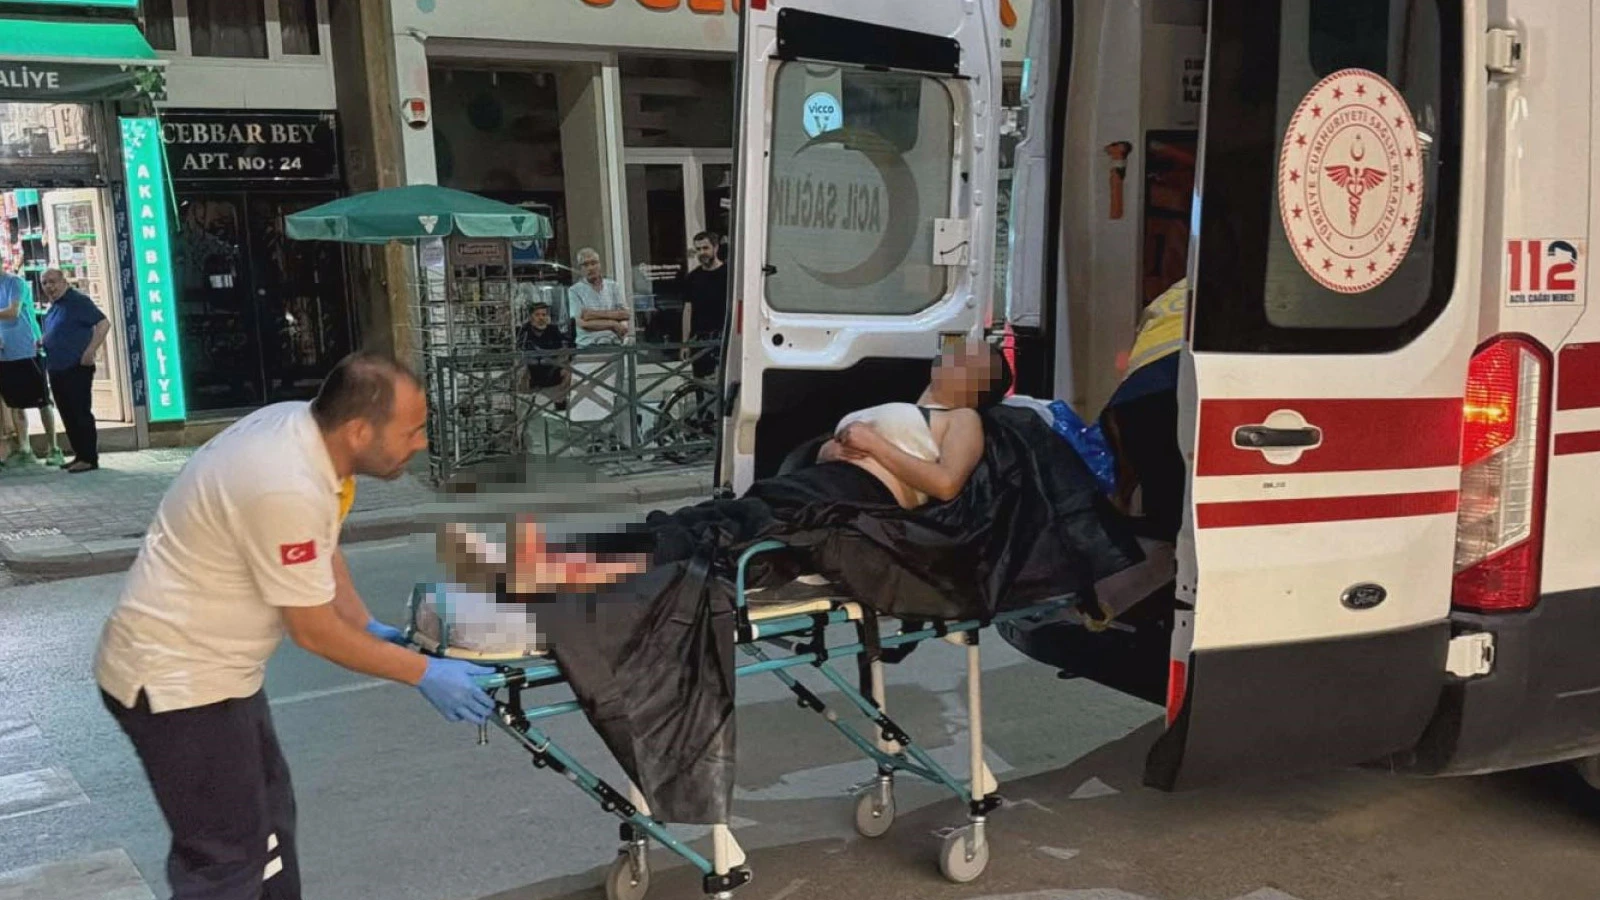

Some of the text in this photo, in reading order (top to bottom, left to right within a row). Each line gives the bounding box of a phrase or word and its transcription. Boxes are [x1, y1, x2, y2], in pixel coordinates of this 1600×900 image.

[808, 102, 834, 114] vicco
[161, 123, 317, 144] CEBBAR BEY
[183, 153, 233, 170] APT.
[280, 157, 302, 170] 24
[1508, 240, 1577, 291] 112
[137, 164, 171, 406] AKAN BAKKALİYE
